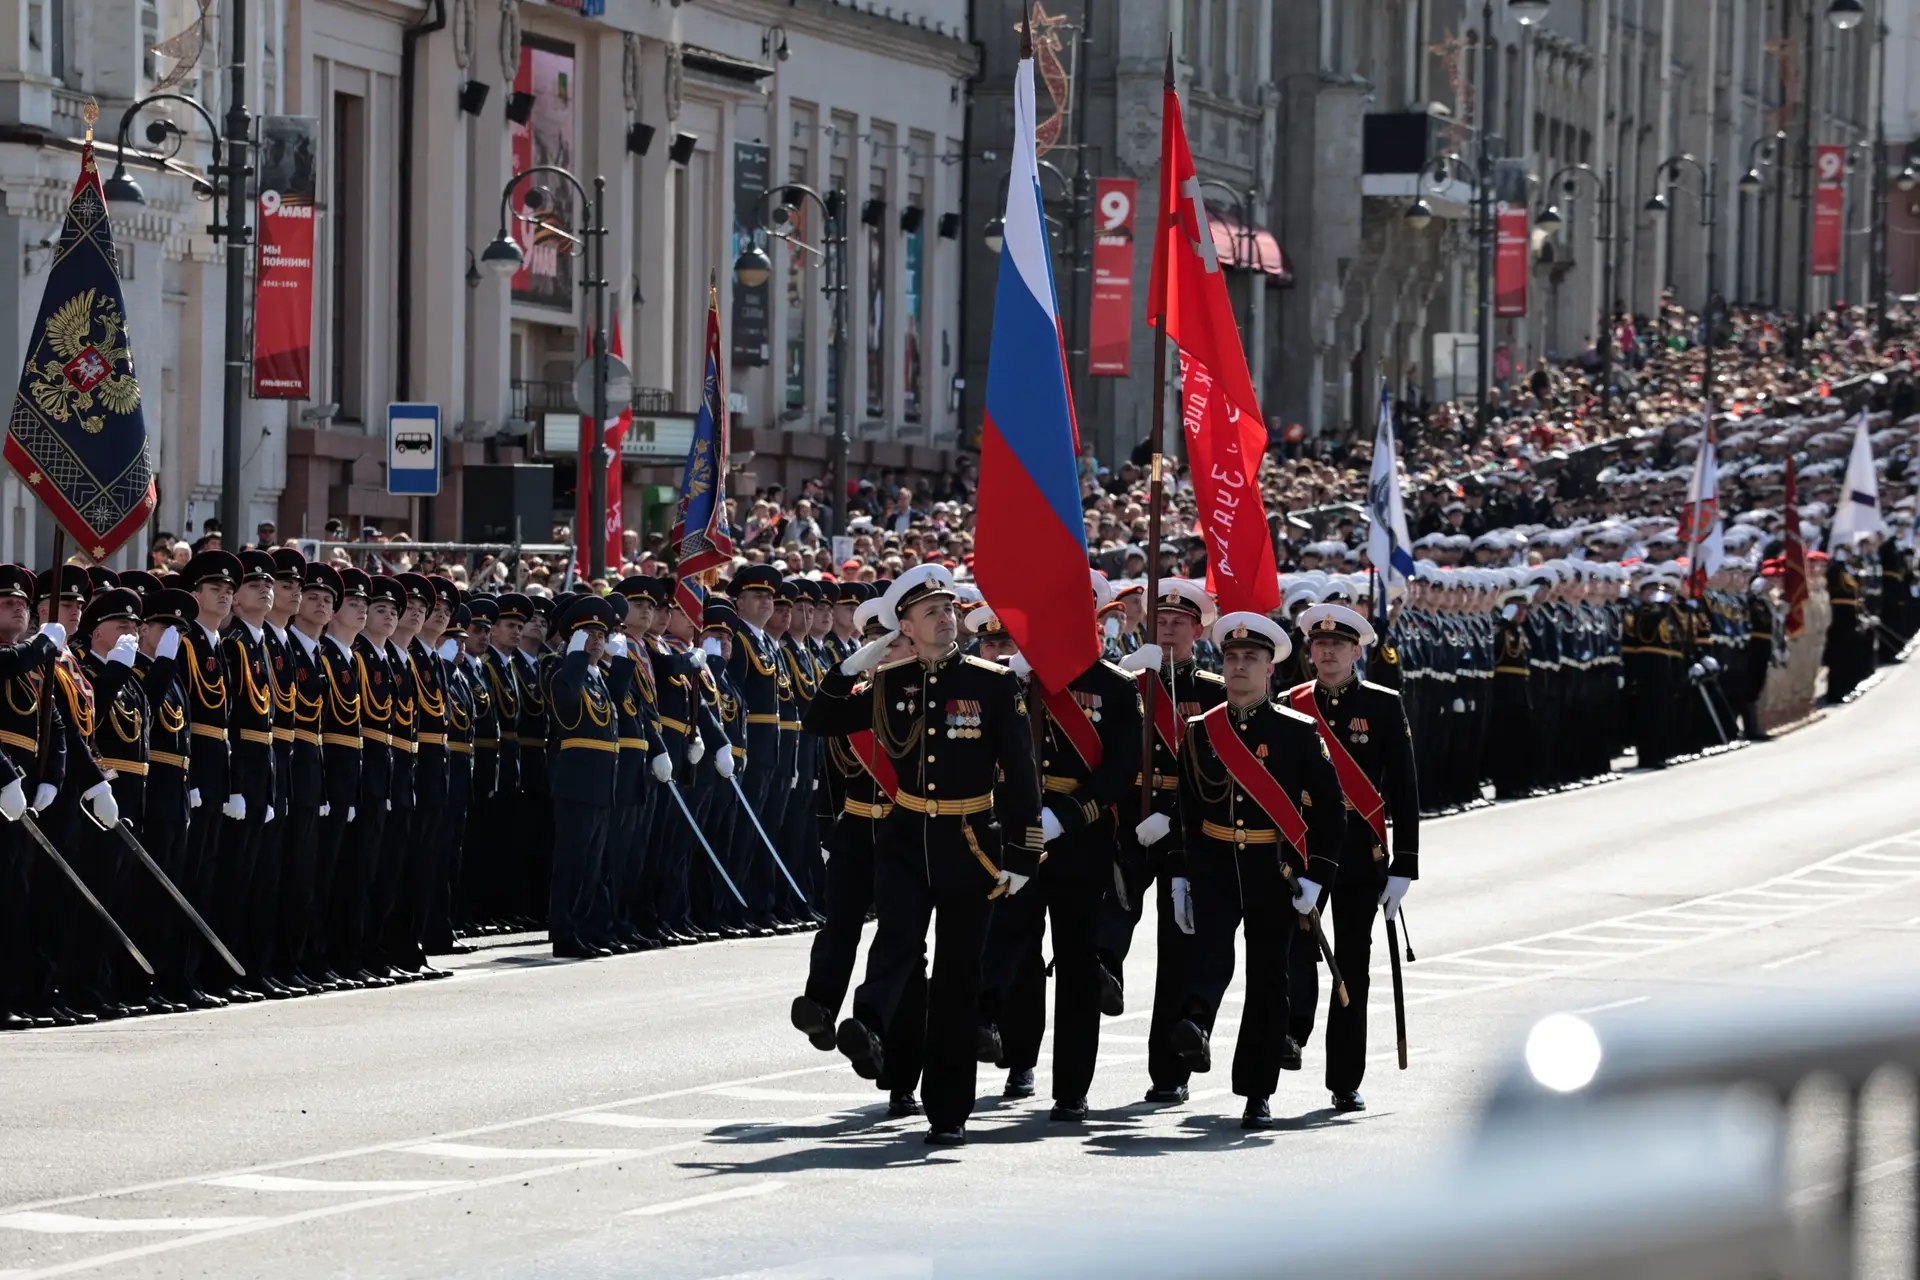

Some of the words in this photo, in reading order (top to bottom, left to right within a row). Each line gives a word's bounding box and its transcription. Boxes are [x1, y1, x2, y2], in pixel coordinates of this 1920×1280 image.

[1818, 153, 1840, 180] 9
[261, 189, 281, 217] 9
[278, 206, 313, 218] МАЯ
[1101, 191, 1130, 231] 9
[262, 256, 311, 268] ПОМНИМ!
[263, 245, 281, 255] МЫ
